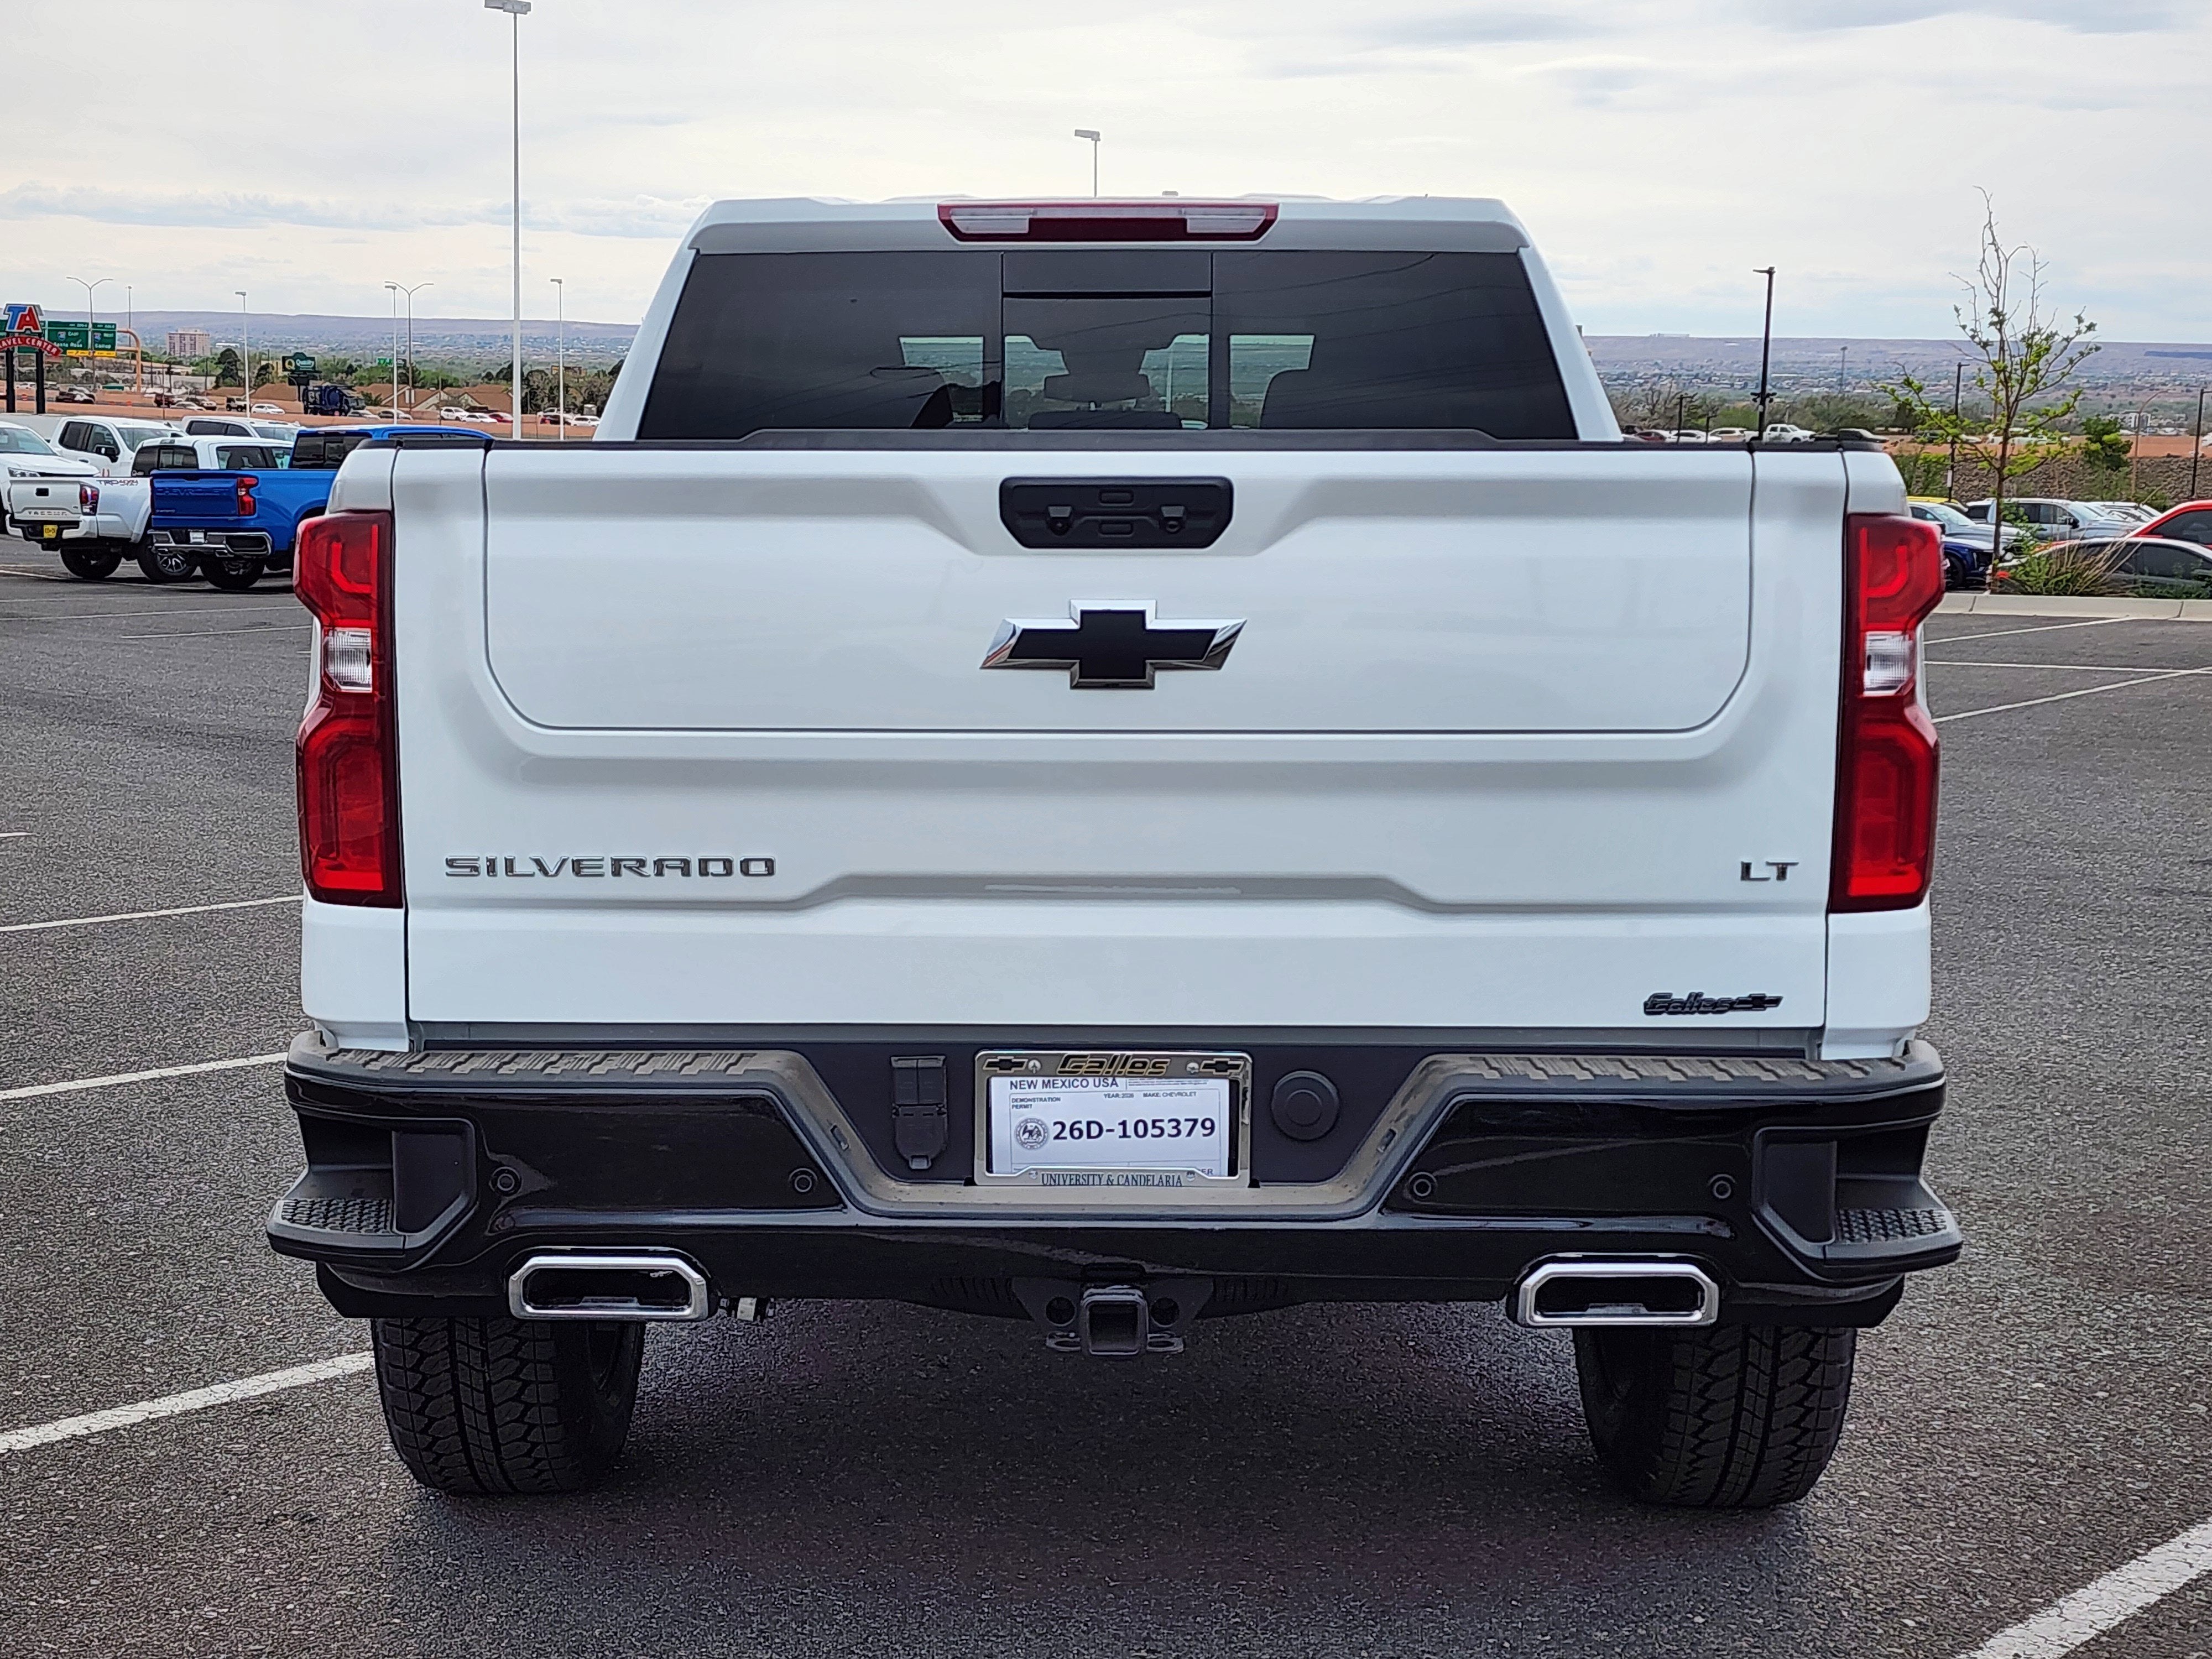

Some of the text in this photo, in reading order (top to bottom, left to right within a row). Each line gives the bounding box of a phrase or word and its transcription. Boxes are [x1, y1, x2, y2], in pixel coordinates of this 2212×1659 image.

[6, 305, 41, 331] TA
[0, 337, 58, 354] AVEL CENTER
[445, 855, 775, 878] SILVERADO
[1740, 860, 1799, 881] LT
[1056, 1051, 1171, 1076] Galles
[1010, 1079, 1038, 1090] NEW
[1041, 1078, 1089, 1089] MEXICO
[1093, 1077, 1119, 1088] USA
[1052, 1117, 1216, 1140] 26D-105379
[1041, 1173, 1182, 1187] UNIVERSITY & CANDELARIA
